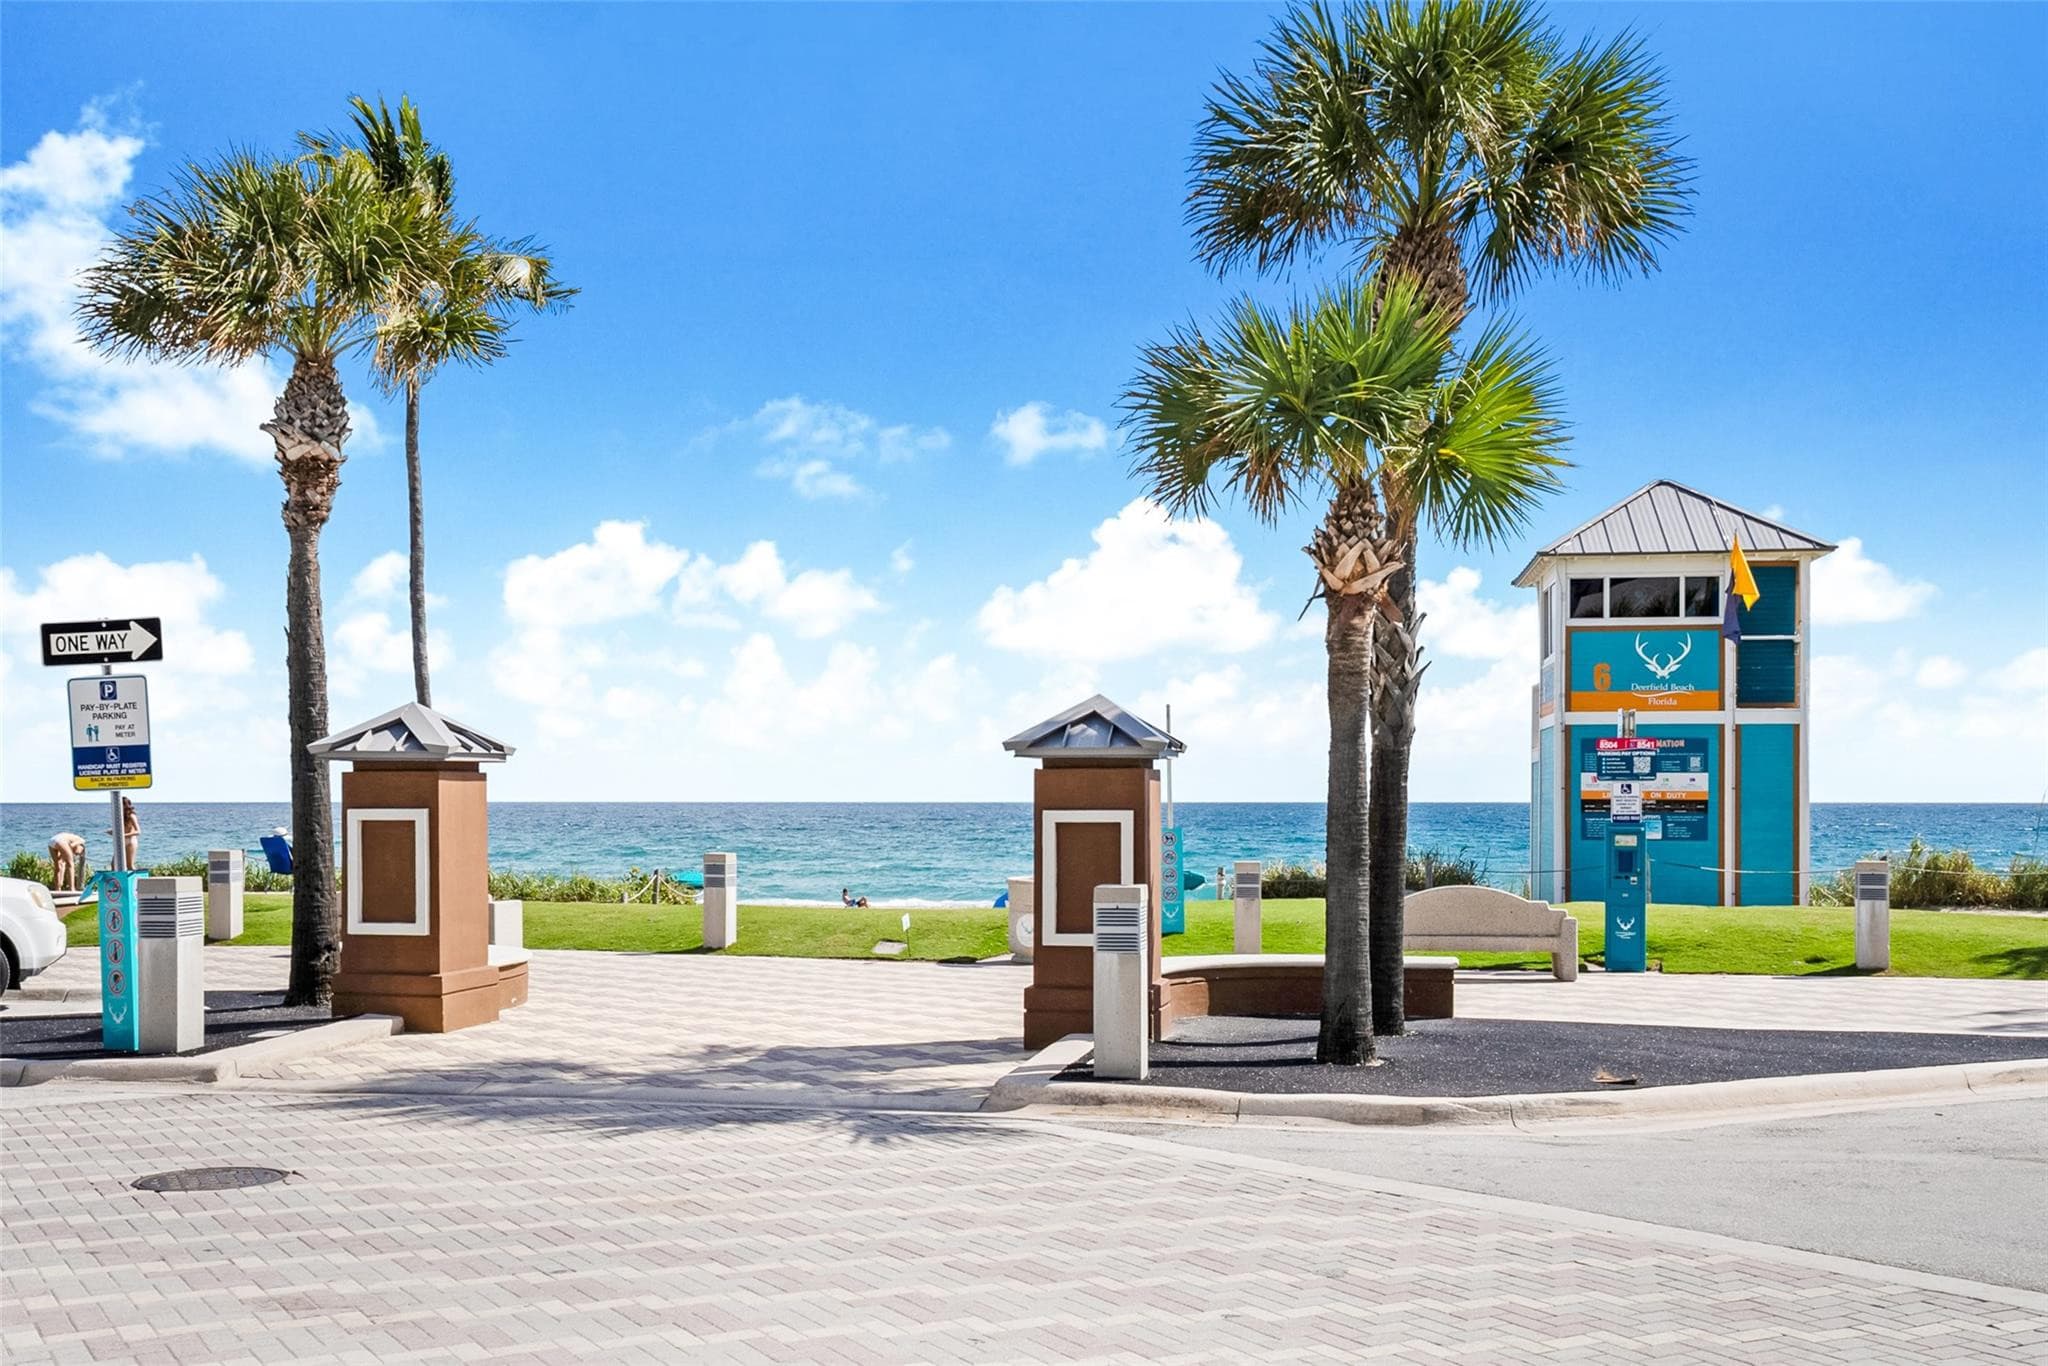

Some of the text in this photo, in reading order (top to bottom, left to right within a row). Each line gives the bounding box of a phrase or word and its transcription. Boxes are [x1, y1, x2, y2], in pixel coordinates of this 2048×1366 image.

[55, 633, 128, 652] ONE WAY
[1593, 662, 1612, 691] 6
[104, 684, 114, 697] P
[1631, 683, 1696, 691] Deerfield Beach
[1648, 697, 1678, 705] Florida
[80, 702, 138, 711] PAY-BY-PLATE
[92, 711, 128, 720] PARKING
[1650, 791, 1662, 799] ON
[1666, 791, 1687, 799] DUTY
